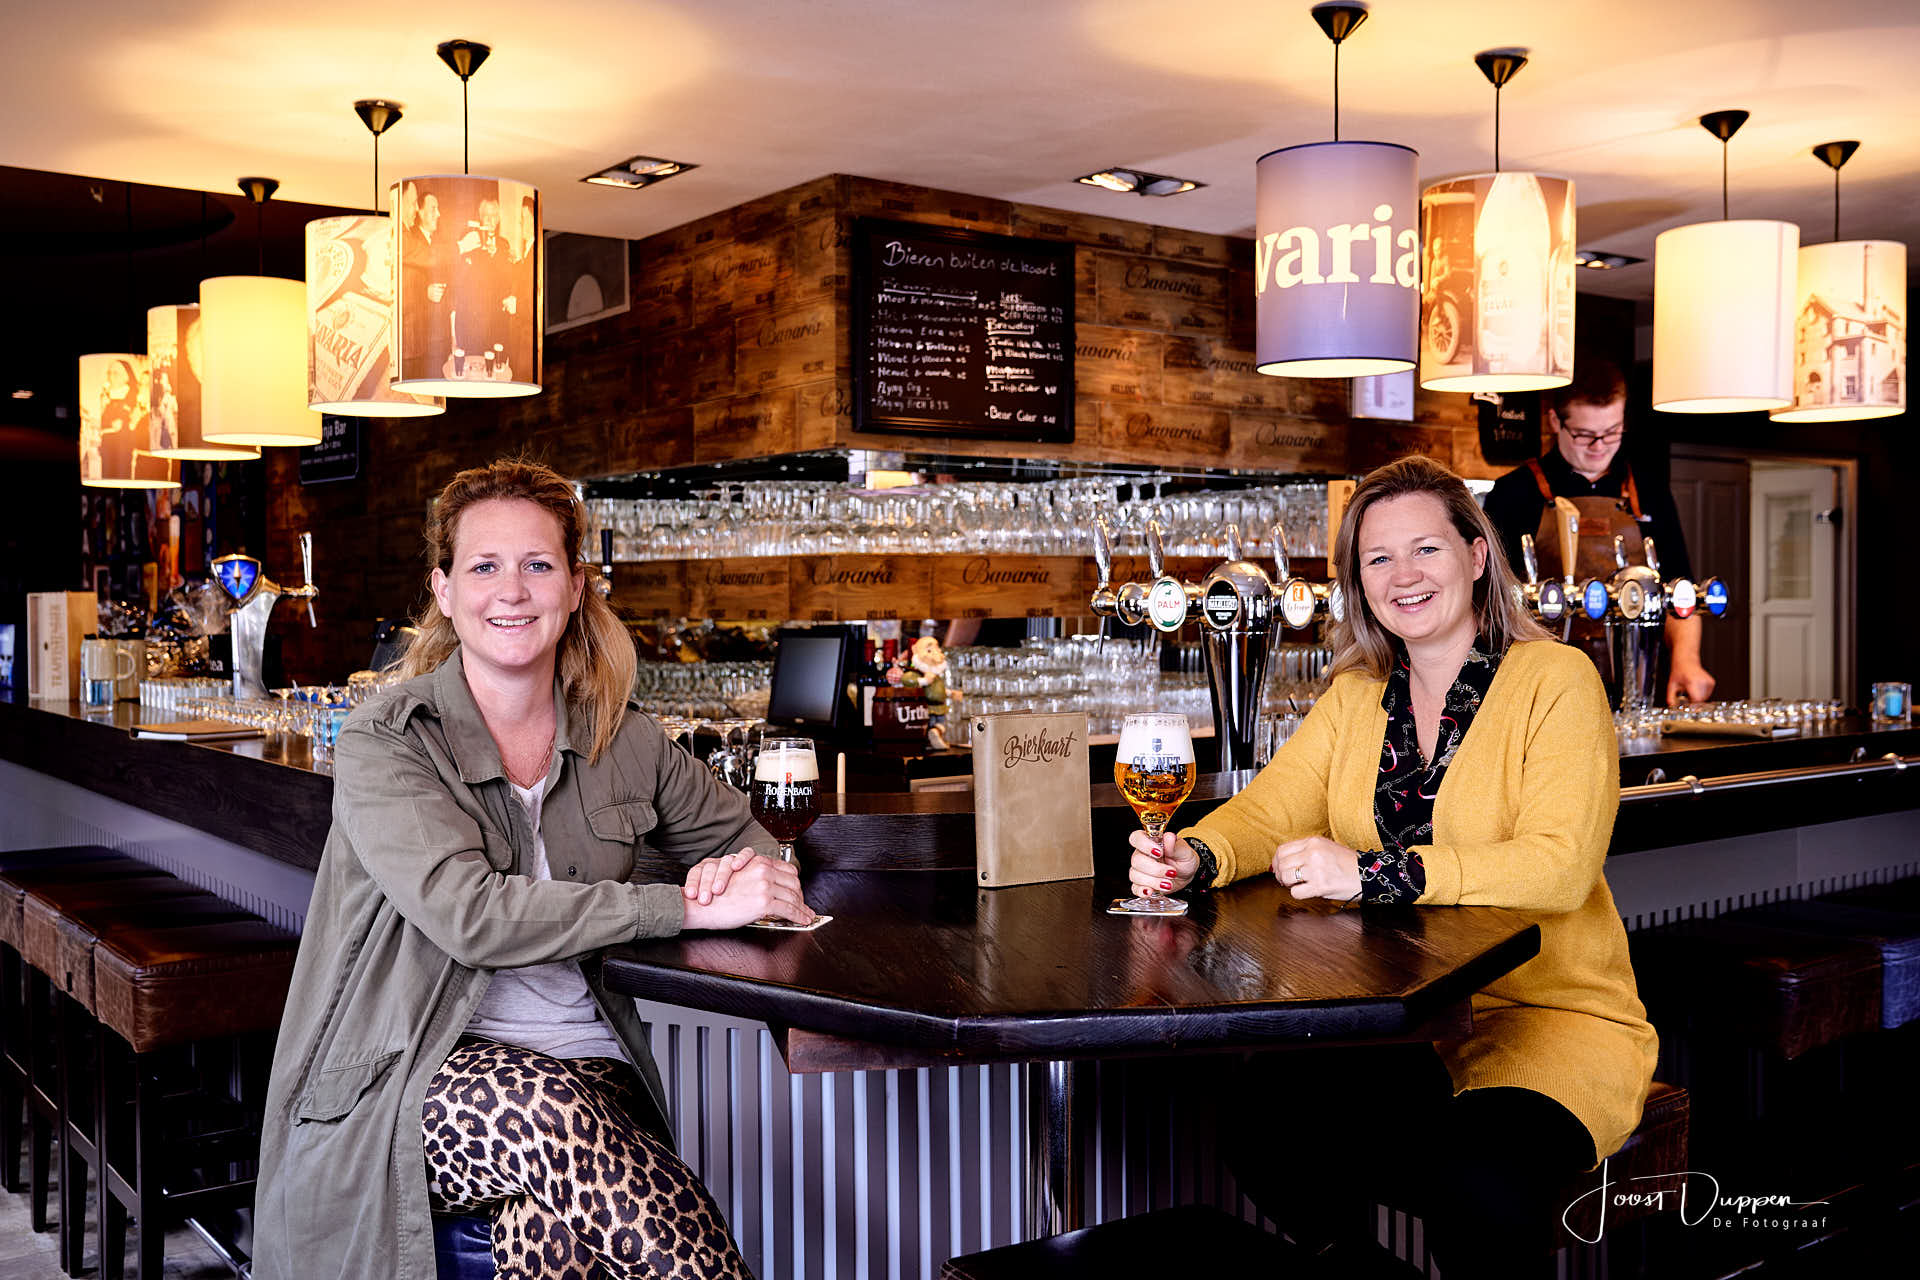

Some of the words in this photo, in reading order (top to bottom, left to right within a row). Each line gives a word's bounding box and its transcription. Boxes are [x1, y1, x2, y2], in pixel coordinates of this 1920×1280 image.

[882, 241, 944, 268] Bieren
[949, 253, 996, 269] buiten
[1124, 263, 1201, 296] Bavaria
[1126, 412, 1202, 441] Bavaria
[811, 557, 895, 586] Bavaria
[962, 557, 1049, 584] Bavaria
[1157, 600, 1180, 609] PALM
[1003, 727, 1078, 769] Bierkaart
